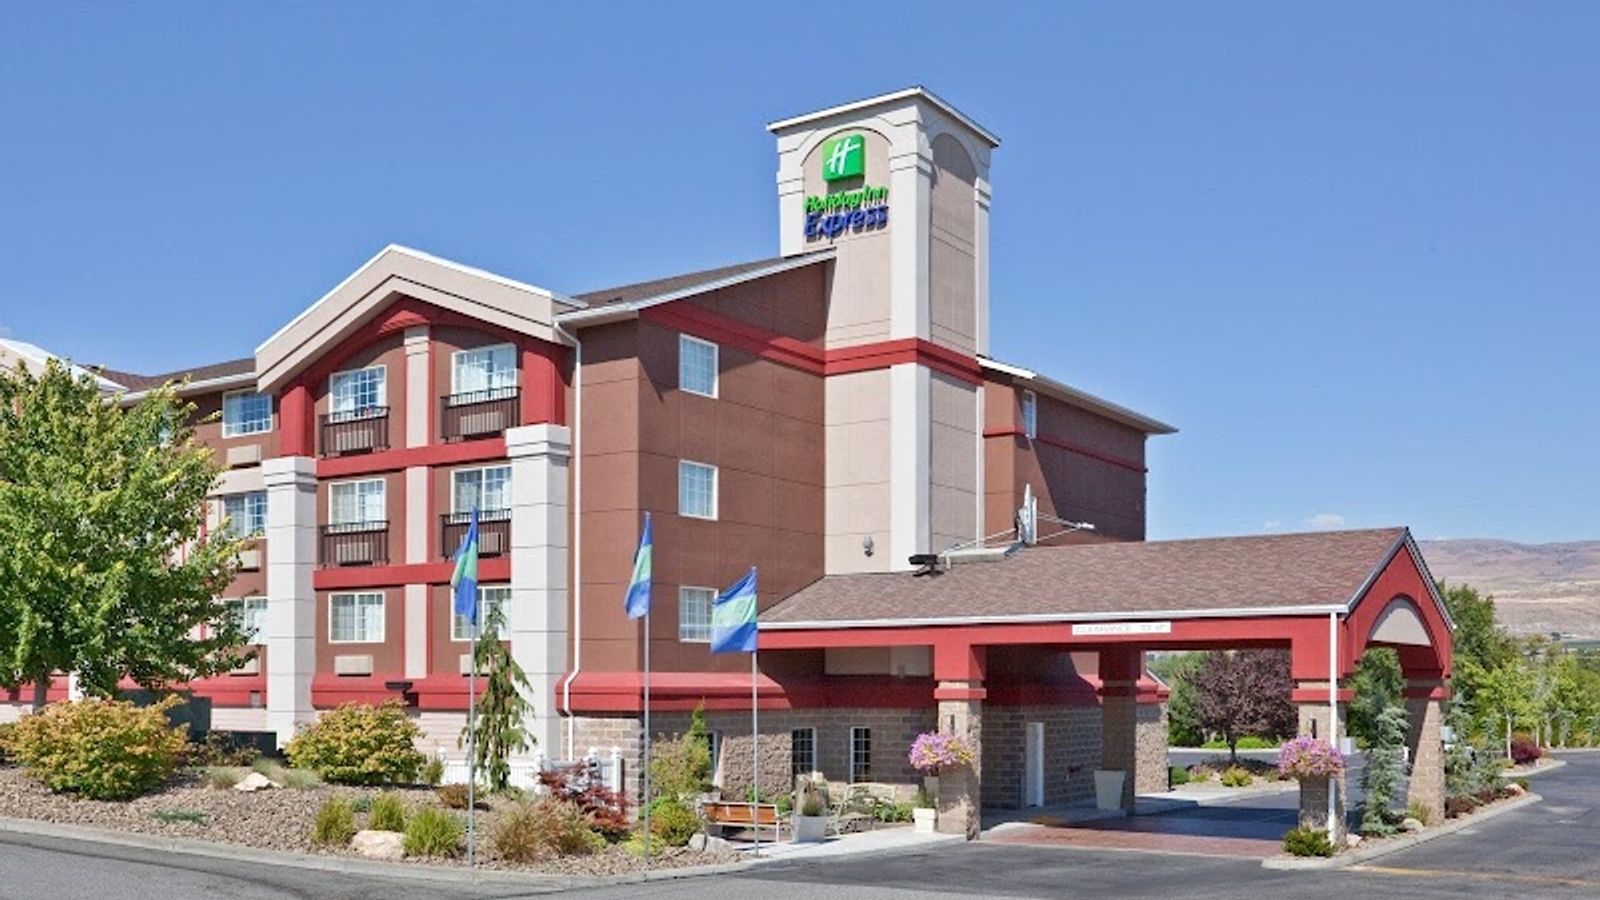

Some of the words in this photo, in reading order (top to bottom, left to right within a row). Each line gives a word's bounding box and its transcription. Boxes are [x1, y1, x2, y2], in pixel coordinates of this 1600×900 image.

[805, 191, 863, 211] Holiday
[863, 184, 888, 202] Inn
[804, 205, 888, 236] Express
